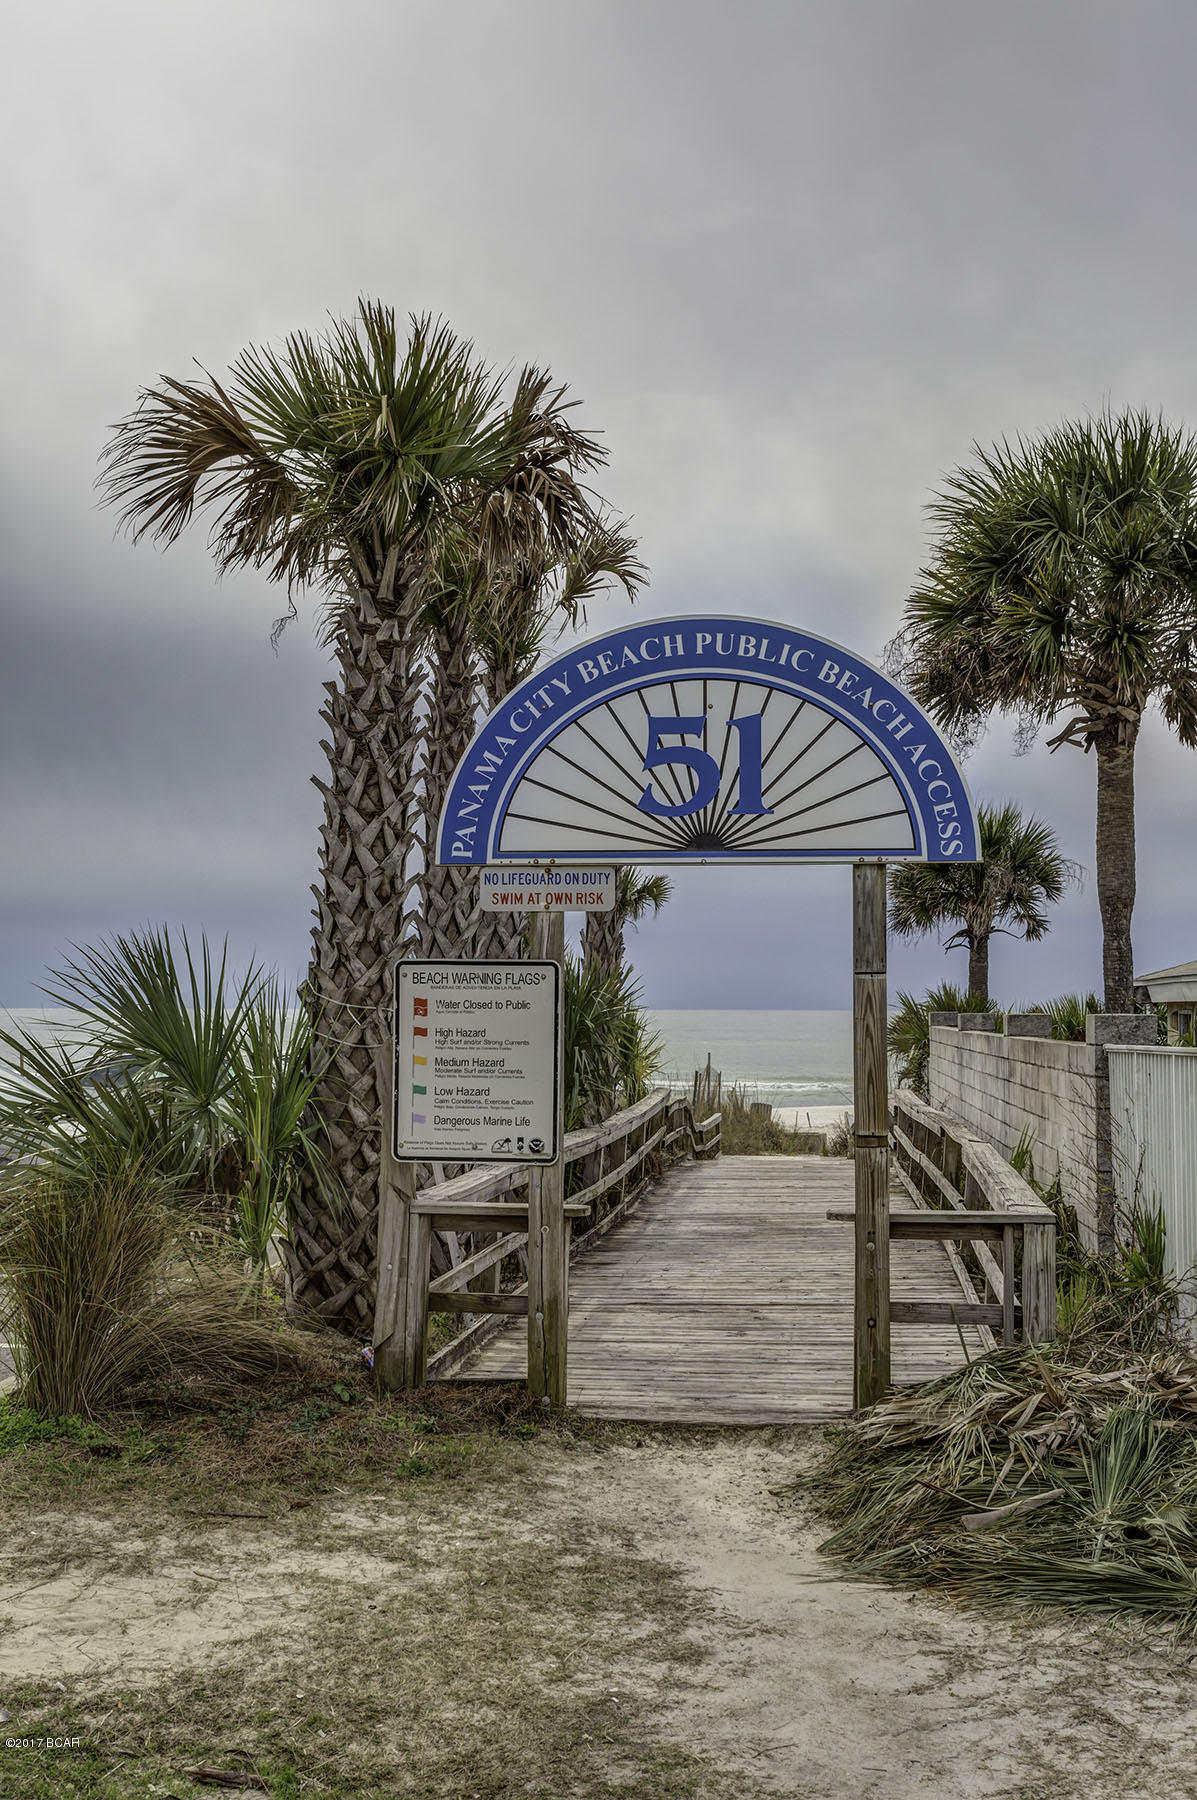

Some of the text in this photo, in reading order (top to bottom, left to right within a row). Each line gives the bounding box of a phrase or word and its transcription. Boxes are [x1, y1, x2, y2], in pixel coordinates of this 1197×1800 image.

[451, 631, 964, 858] PANAMA CITY BEACH PUBLIC BEACH ACCESS
[637, 713, 775, 817] 51
[484, 872, 611, 886] NO LIFEGUARD ON DUTY
[491, 892, 604, 905] SWIM AT OWN RISK
[412, 971, 541, 986] BEACH WARNING FLAGS
[435, 999, 532, 1010] Water Closed to Public
[435, 1028, 486, 1039] High Hazard
[434, 1057, 505, 1067] Medium Hazard
[434, 1086, 490, 1097] Low Hazard
[433, 1115, 531, 1128] Dangerous Marine Life
